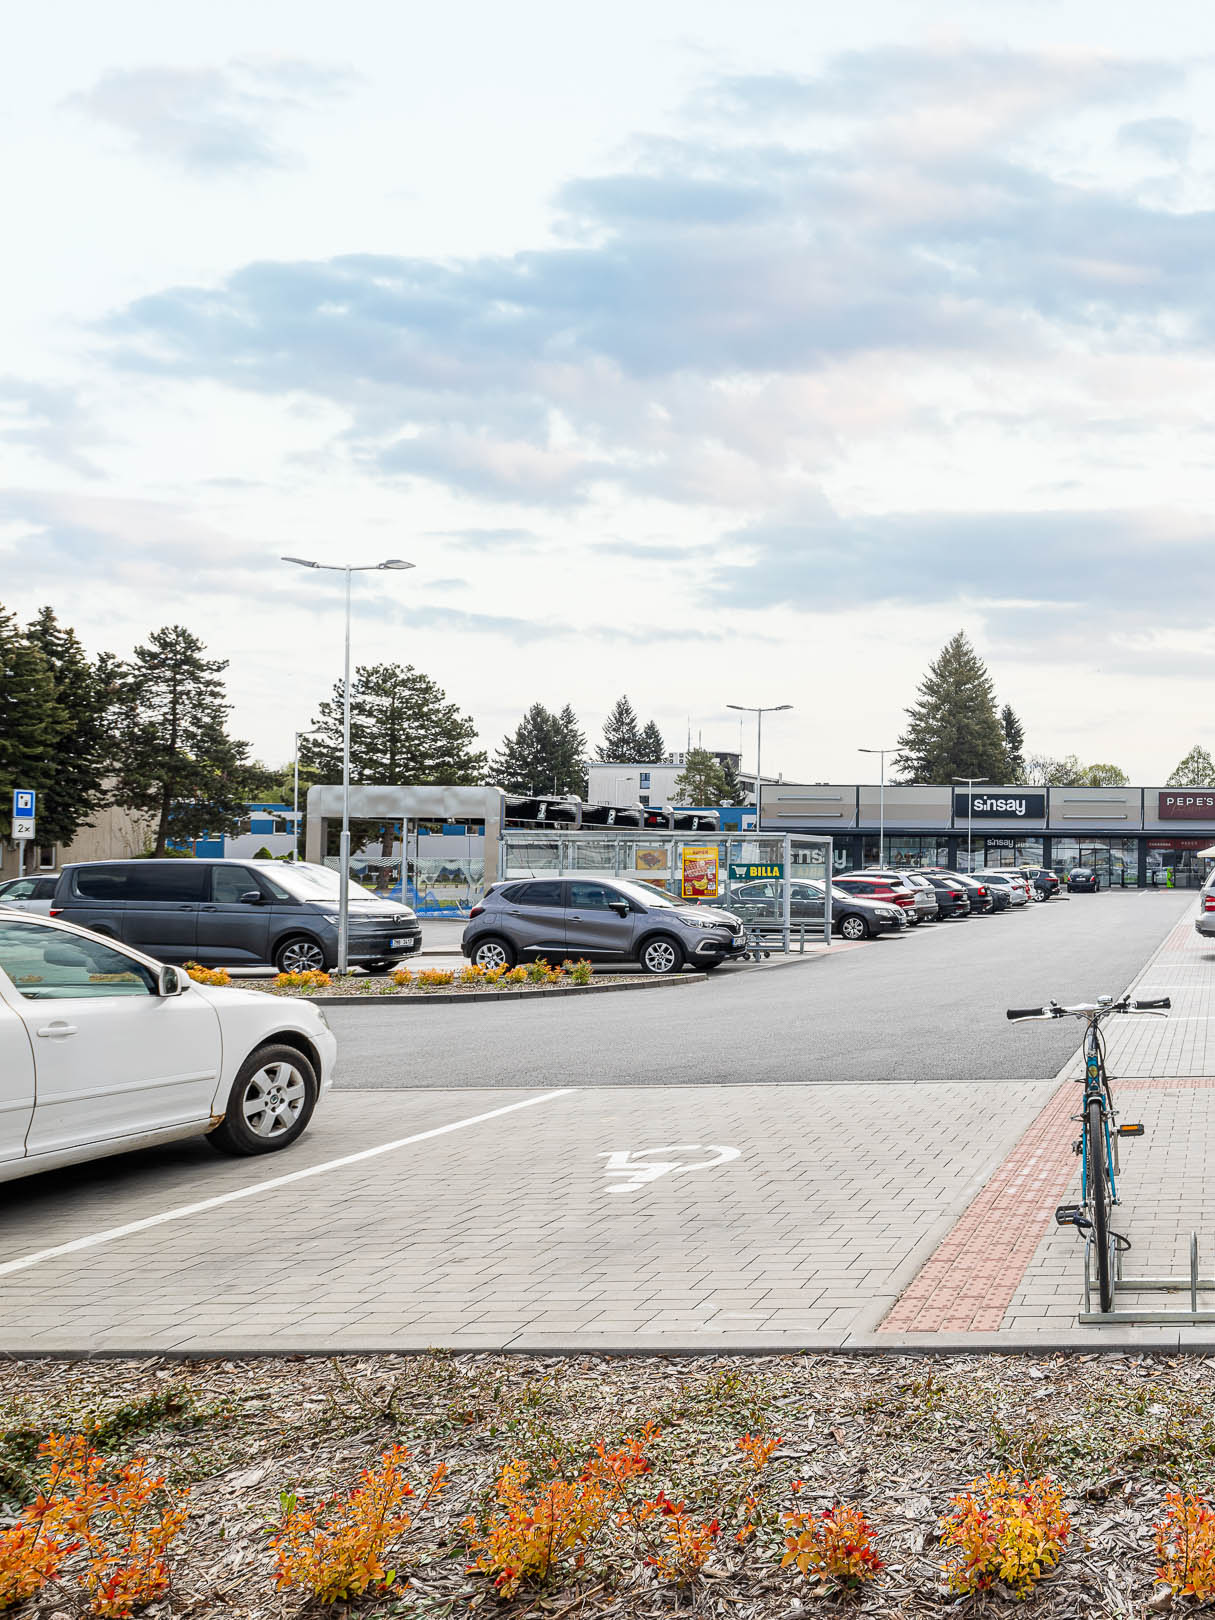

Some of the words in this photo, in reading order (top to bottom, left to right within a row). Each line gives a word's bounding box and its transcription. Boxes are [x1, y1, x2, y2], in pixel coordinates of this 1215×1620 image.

[973, 795, 1026, 816] sinsay
[1166, 797, 1214, 806] PEPE'S
[987, 838, 1014, 848] sinsay
[749, 866, 780, 877] BILLA
